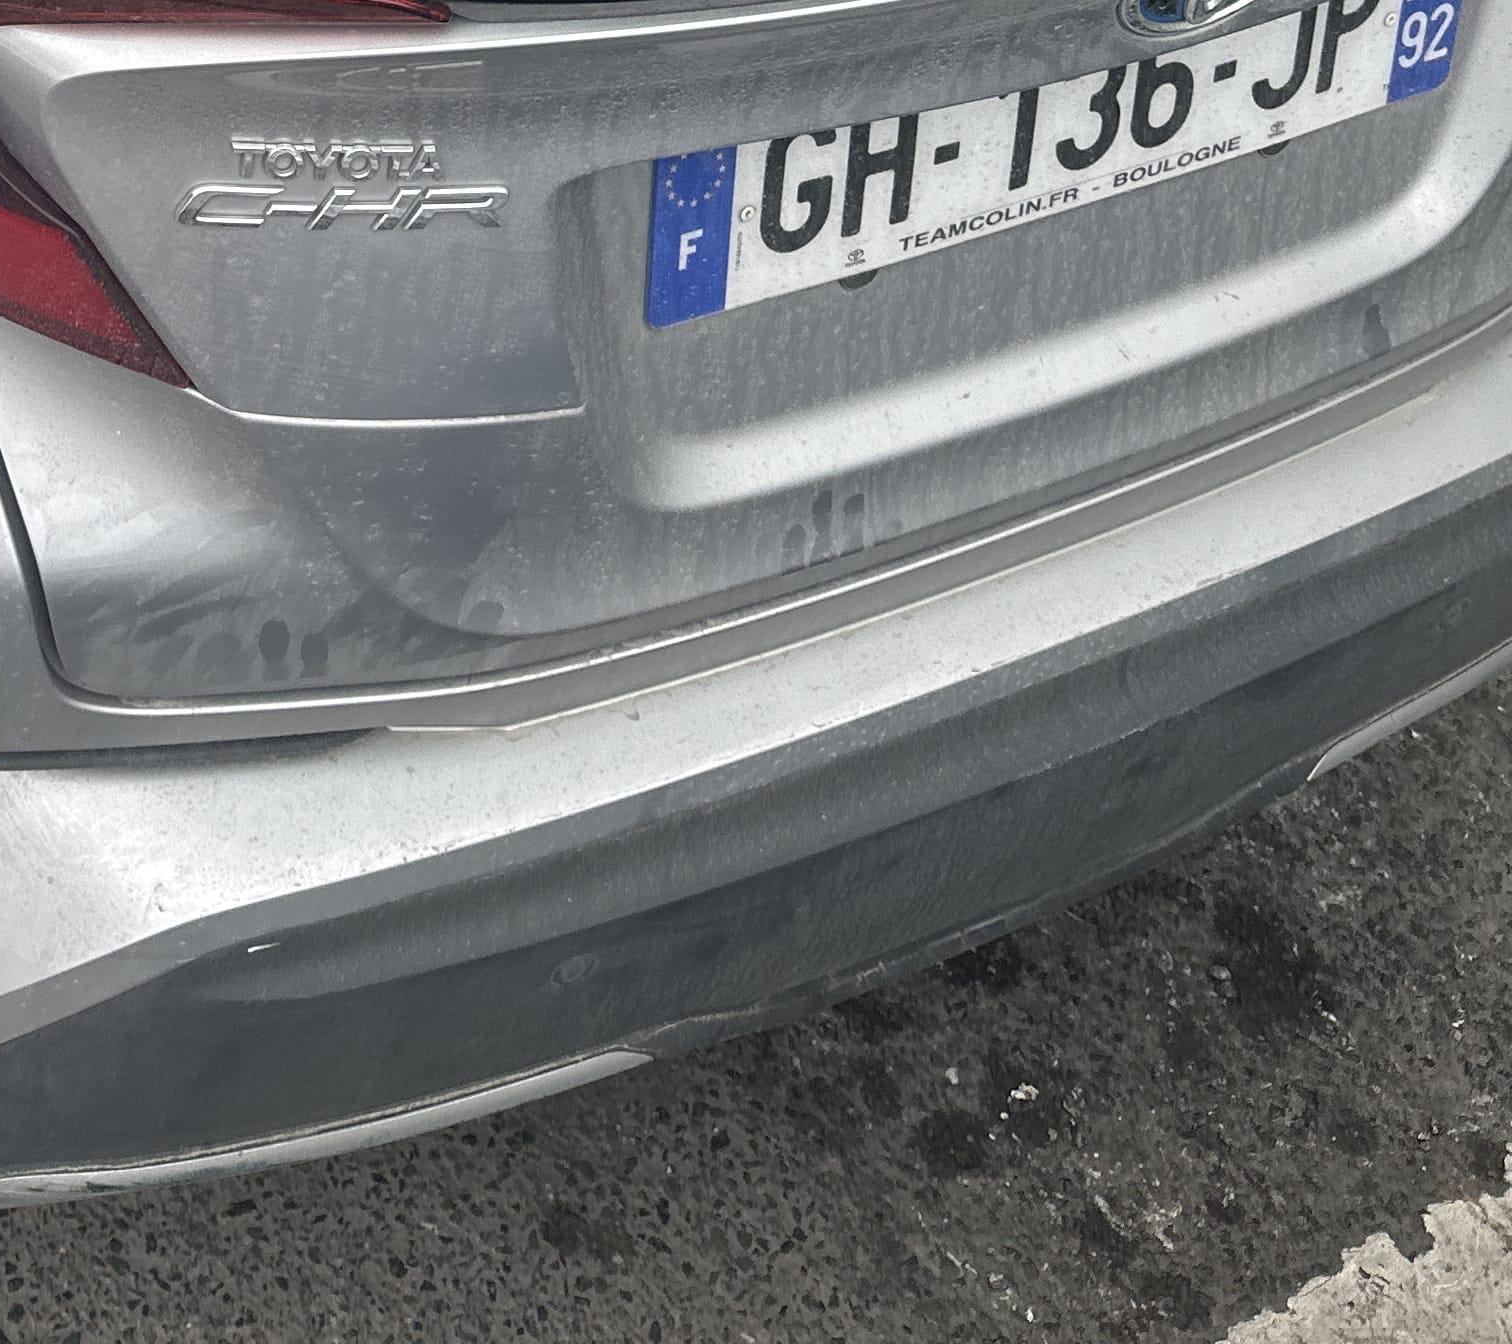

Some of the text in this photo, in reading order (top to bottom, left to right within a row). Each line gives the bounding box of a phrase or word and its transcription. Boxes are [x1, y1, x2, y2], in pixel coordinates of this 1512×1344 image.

[1398, 2, 1455, 69] 92
[230, 136, 445, 180] TOYOTA
[175, 182, 510, 231] C-HR
[898, 186, 1080, 252] TEAMCOLIN.FR
[1112, 135, 1243, 189] BOULOGNE
[678, 228, 704, 271] F
